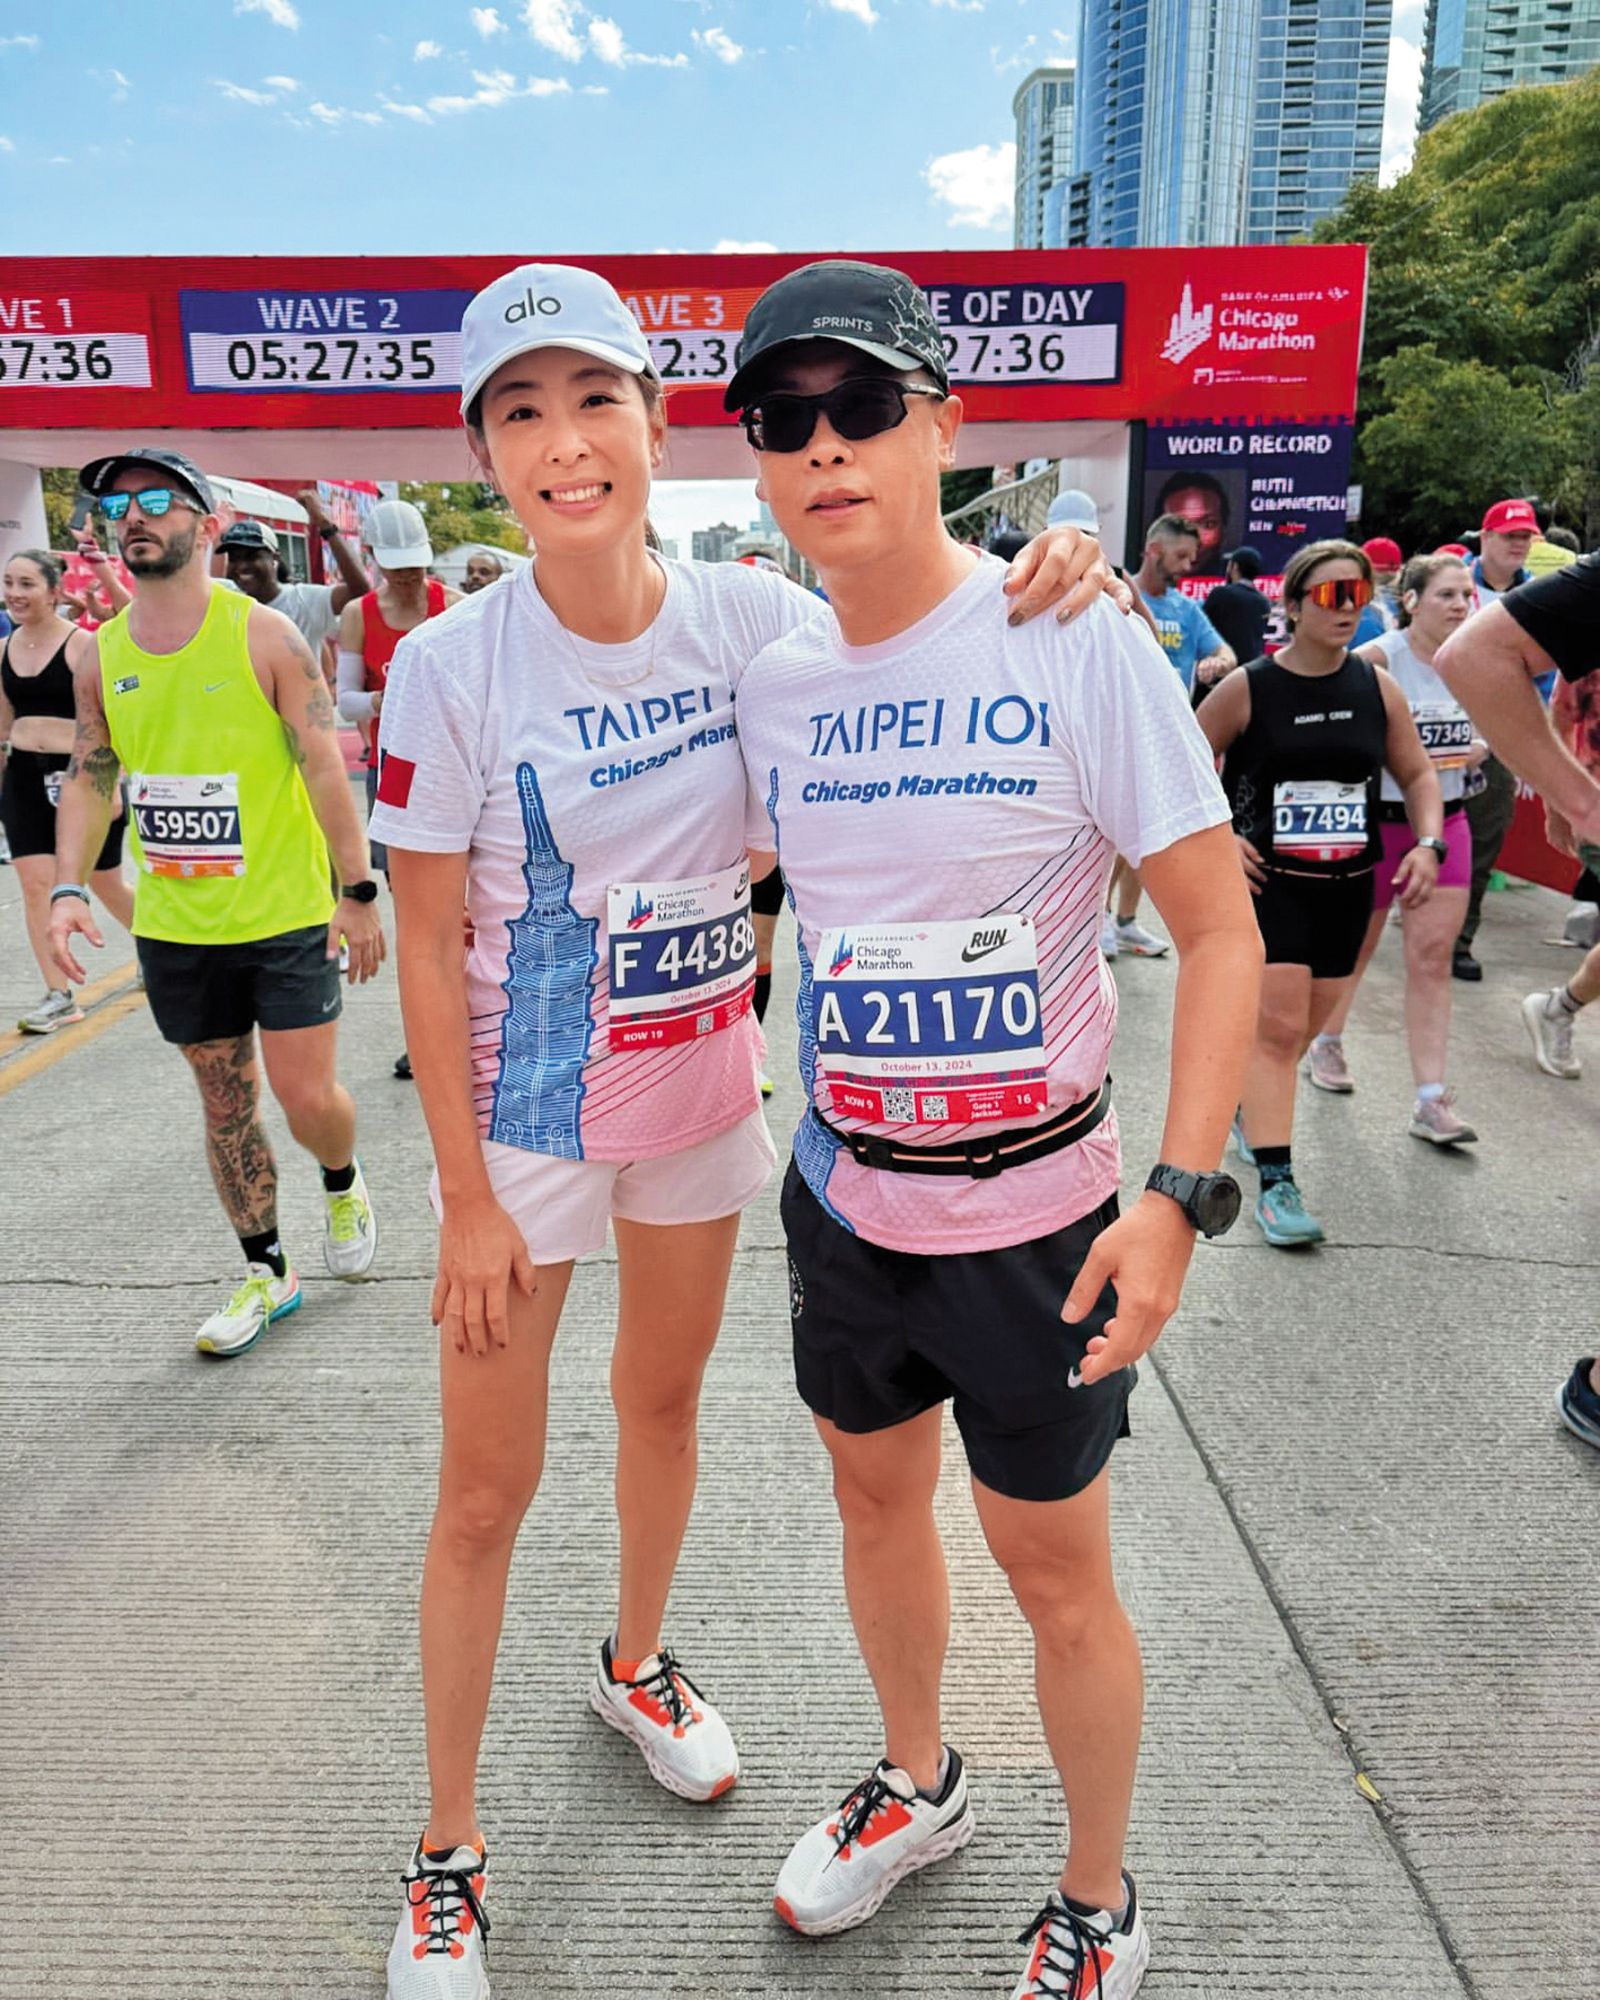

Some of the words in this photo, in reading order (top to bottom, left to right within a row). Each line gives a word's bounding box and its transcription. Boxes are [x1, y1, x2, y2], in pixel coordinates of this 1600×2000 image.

[57, 299, 73, 328] 1
[258, 297, 368, 329] WAVE
[379, 298, 400, 329] 2
[505, 287, 562, 323] alo
[703, 296, 725, 326] 3
[963, 290, 1011, 323] OF
[1022, 290, 1093, 322] DAY
[812, 316, 873, 333] SPRINTS
[1219, 308, 1298, 331] Chicago
[1218, 331, 1315, 351] Marathon
[228, 340, 435, 381] 05:27:35
[647, 338, 743, 377] 2:3
[1168, 435, 1244, 455] WORLD
[1249, 434, 1333, 454] RECORD
[809, 699, 944, 756] TAIPEI
[1422, 723, 1470, 745] 57349
[589, 744, 682, 788] Chicago
[802, 778, 891, 803] Chicago
[896, 772, 1038, 797] Marathon
[135, 808, 151, 838] K
[153, 810, 236, 840] 59507
[1275, 806, 1293, 833] D
[1302, 805, 1366, 832] 7494
[657, 898, 696, 911] Chicago
[657, 907, 705, 922] Marathon
[970, 928, 1008, 948] RUN
[615, 942, 642, 988] F
[857, 946, 902, 959] Chicago
[857, 959, 914, 970] Marathon
[818, 992, 850, 1042] A
[862, 982, 1037, 1043] 21170
[623, 1032, 648, 1042] ROW
[881, 1062, 922, 1073] October
[926, 1061, 942, 1073] 13,
[945, 1060, 973, 1071] 2024
[867, 1099, 874, 1109] 9
[1016, 1093, 1032, 1104] 16
